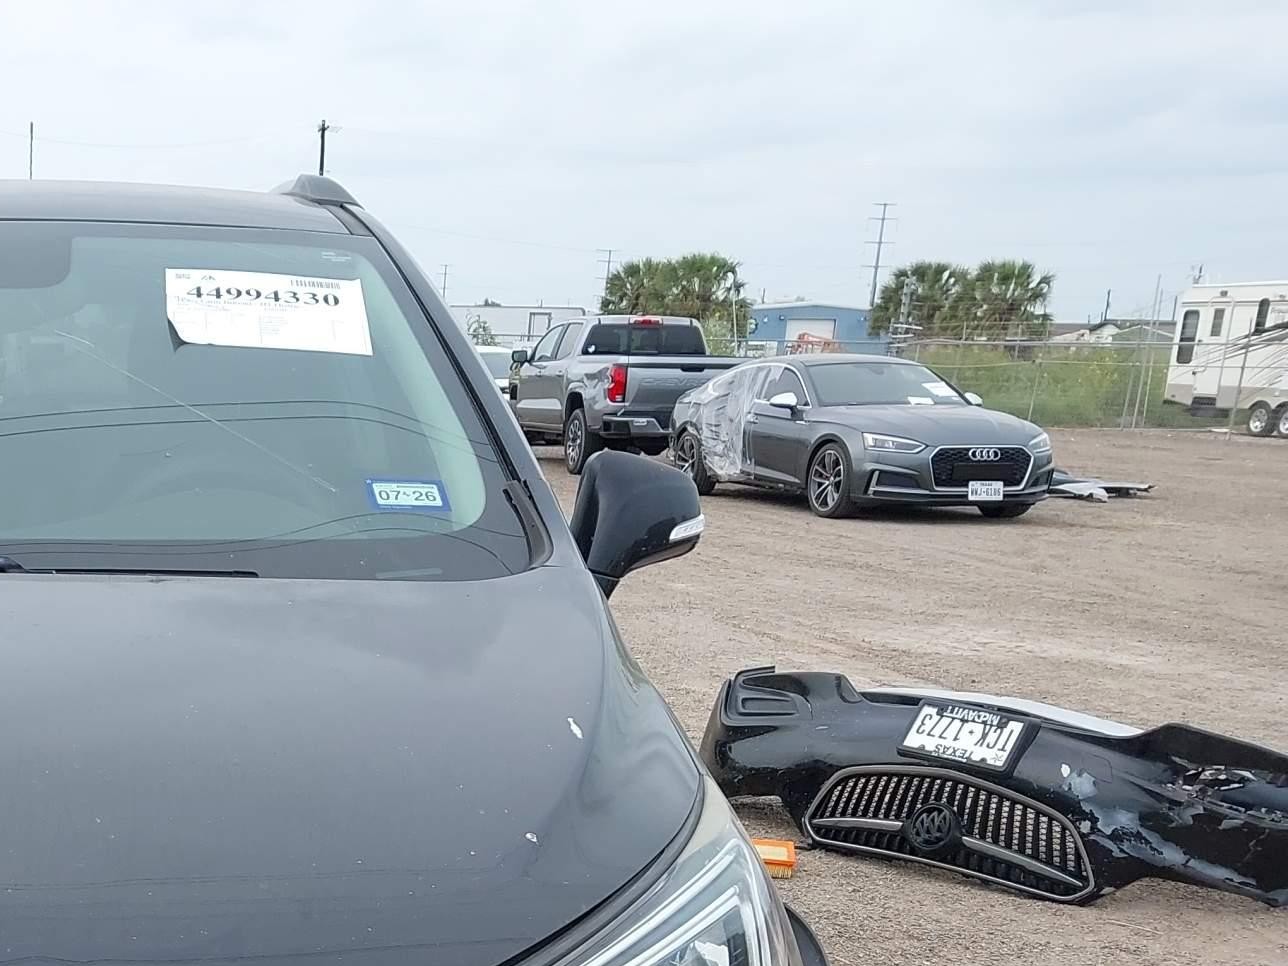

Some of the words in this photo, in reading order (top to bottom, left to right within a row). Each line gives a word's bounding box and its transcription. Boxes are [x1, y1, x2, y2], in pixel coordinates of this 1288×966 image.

[186, 286, 341, 307] 44994330
[378, 489, 402, 502] 07
[412, 490, 438, 502] 26
[943, 705, 1001, 725] McDAVITT
[935, 744, 973, 760] TEXAS
